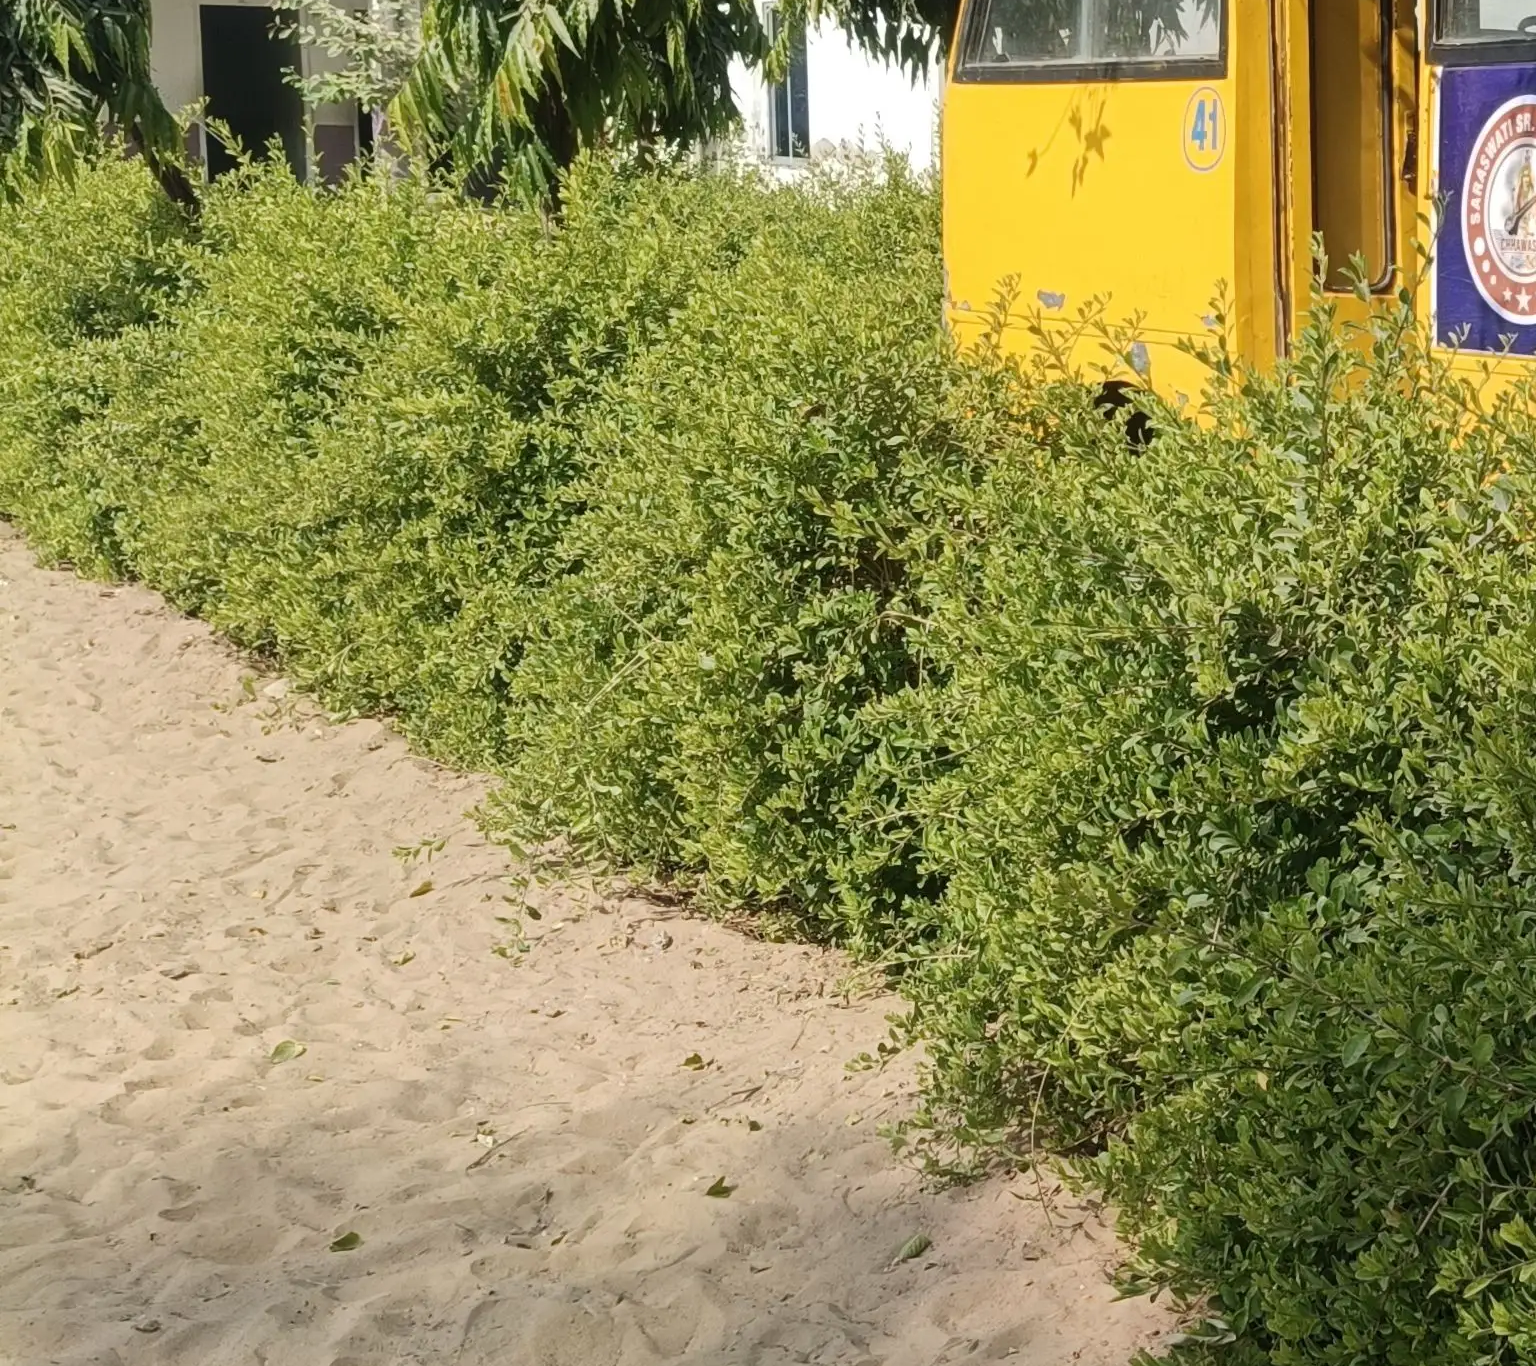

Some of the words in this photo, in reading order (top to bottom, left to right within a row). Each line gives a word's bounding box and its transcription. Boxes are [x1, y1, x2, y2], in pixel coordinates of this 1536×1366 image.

[1191, 98, 1218, 151] 41
[1470, 119, 1513, 225] SARASWATI
[1515, 112, 1535, 134] SR.
